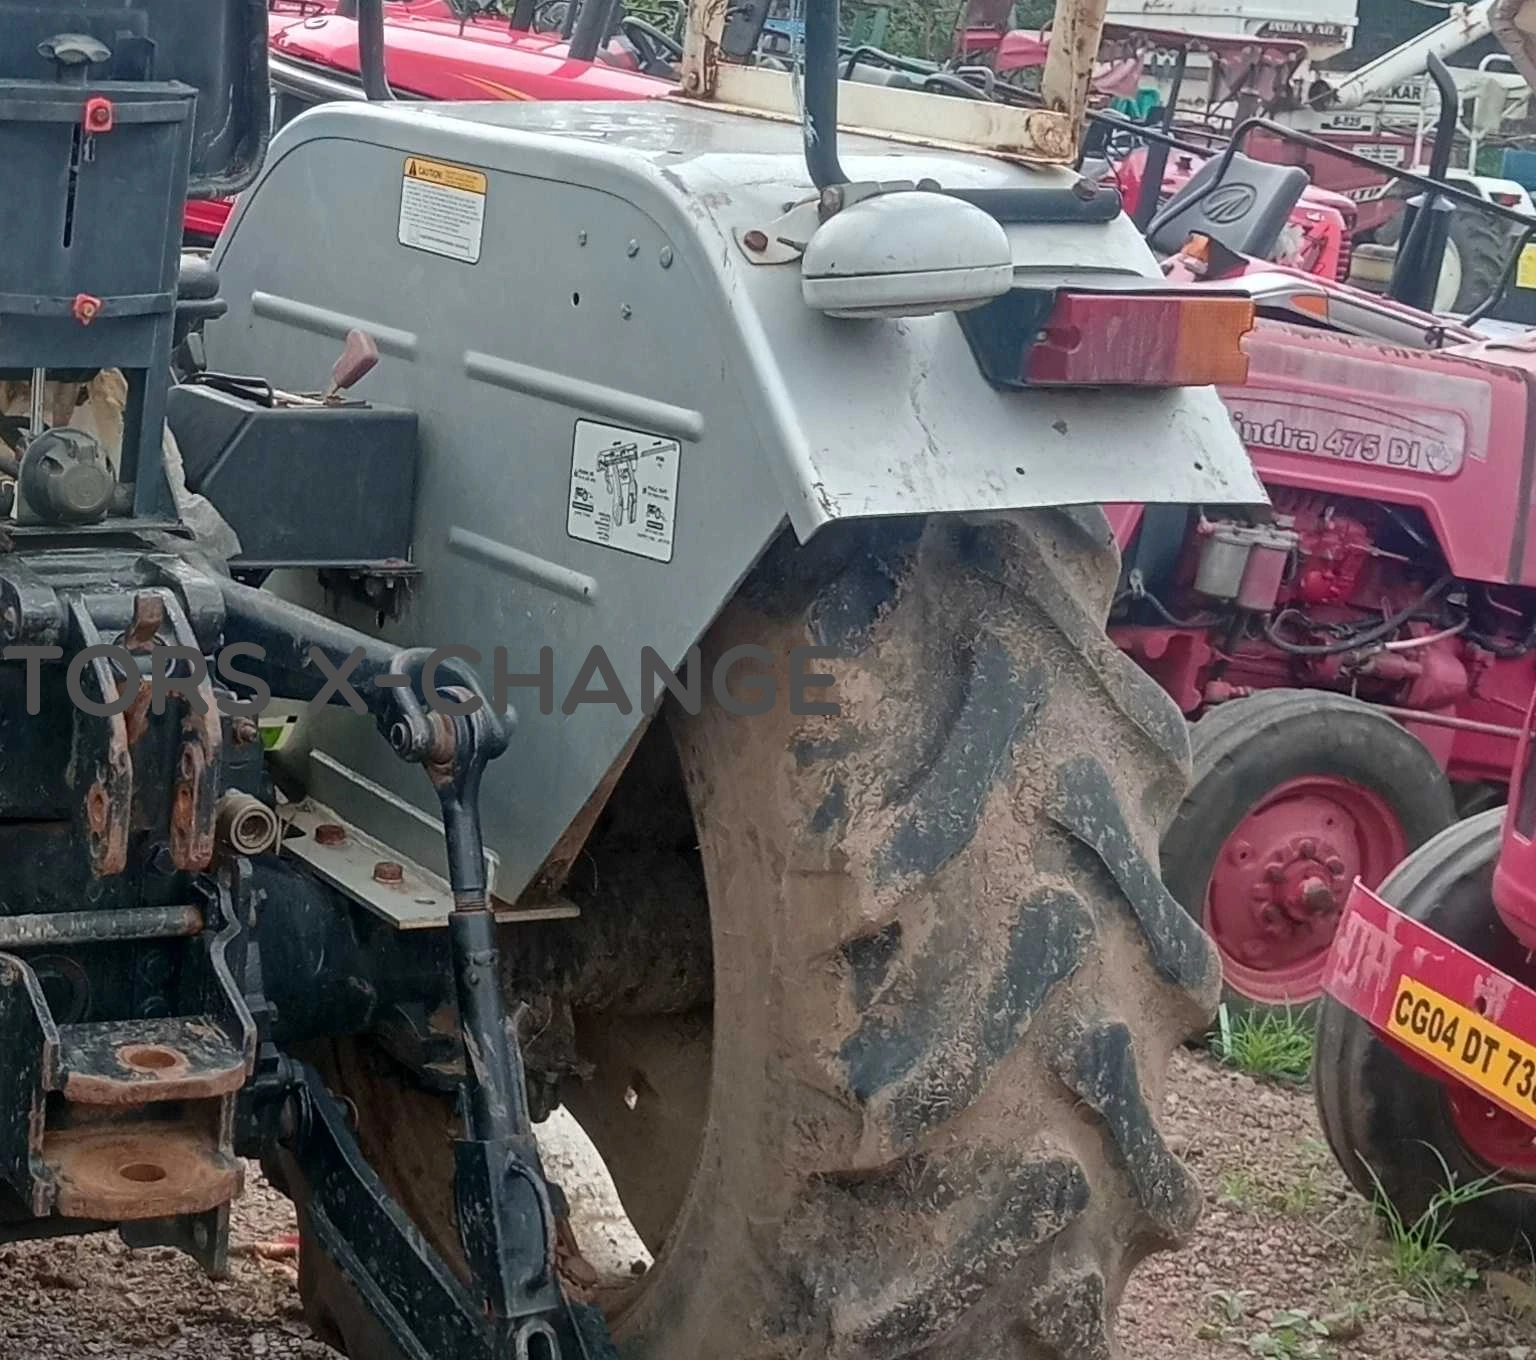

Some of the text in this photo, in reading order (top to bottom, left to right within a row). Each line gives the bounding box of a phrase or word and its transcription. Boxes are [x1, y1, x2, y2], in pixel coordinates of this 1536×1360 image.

[1323, 428, 1381, 461] 475
[1387, 437, 1421, 468] DI
[1395, 990, 1460, 1052] CG04
[1461, 1026, 1500, 1074] DT
